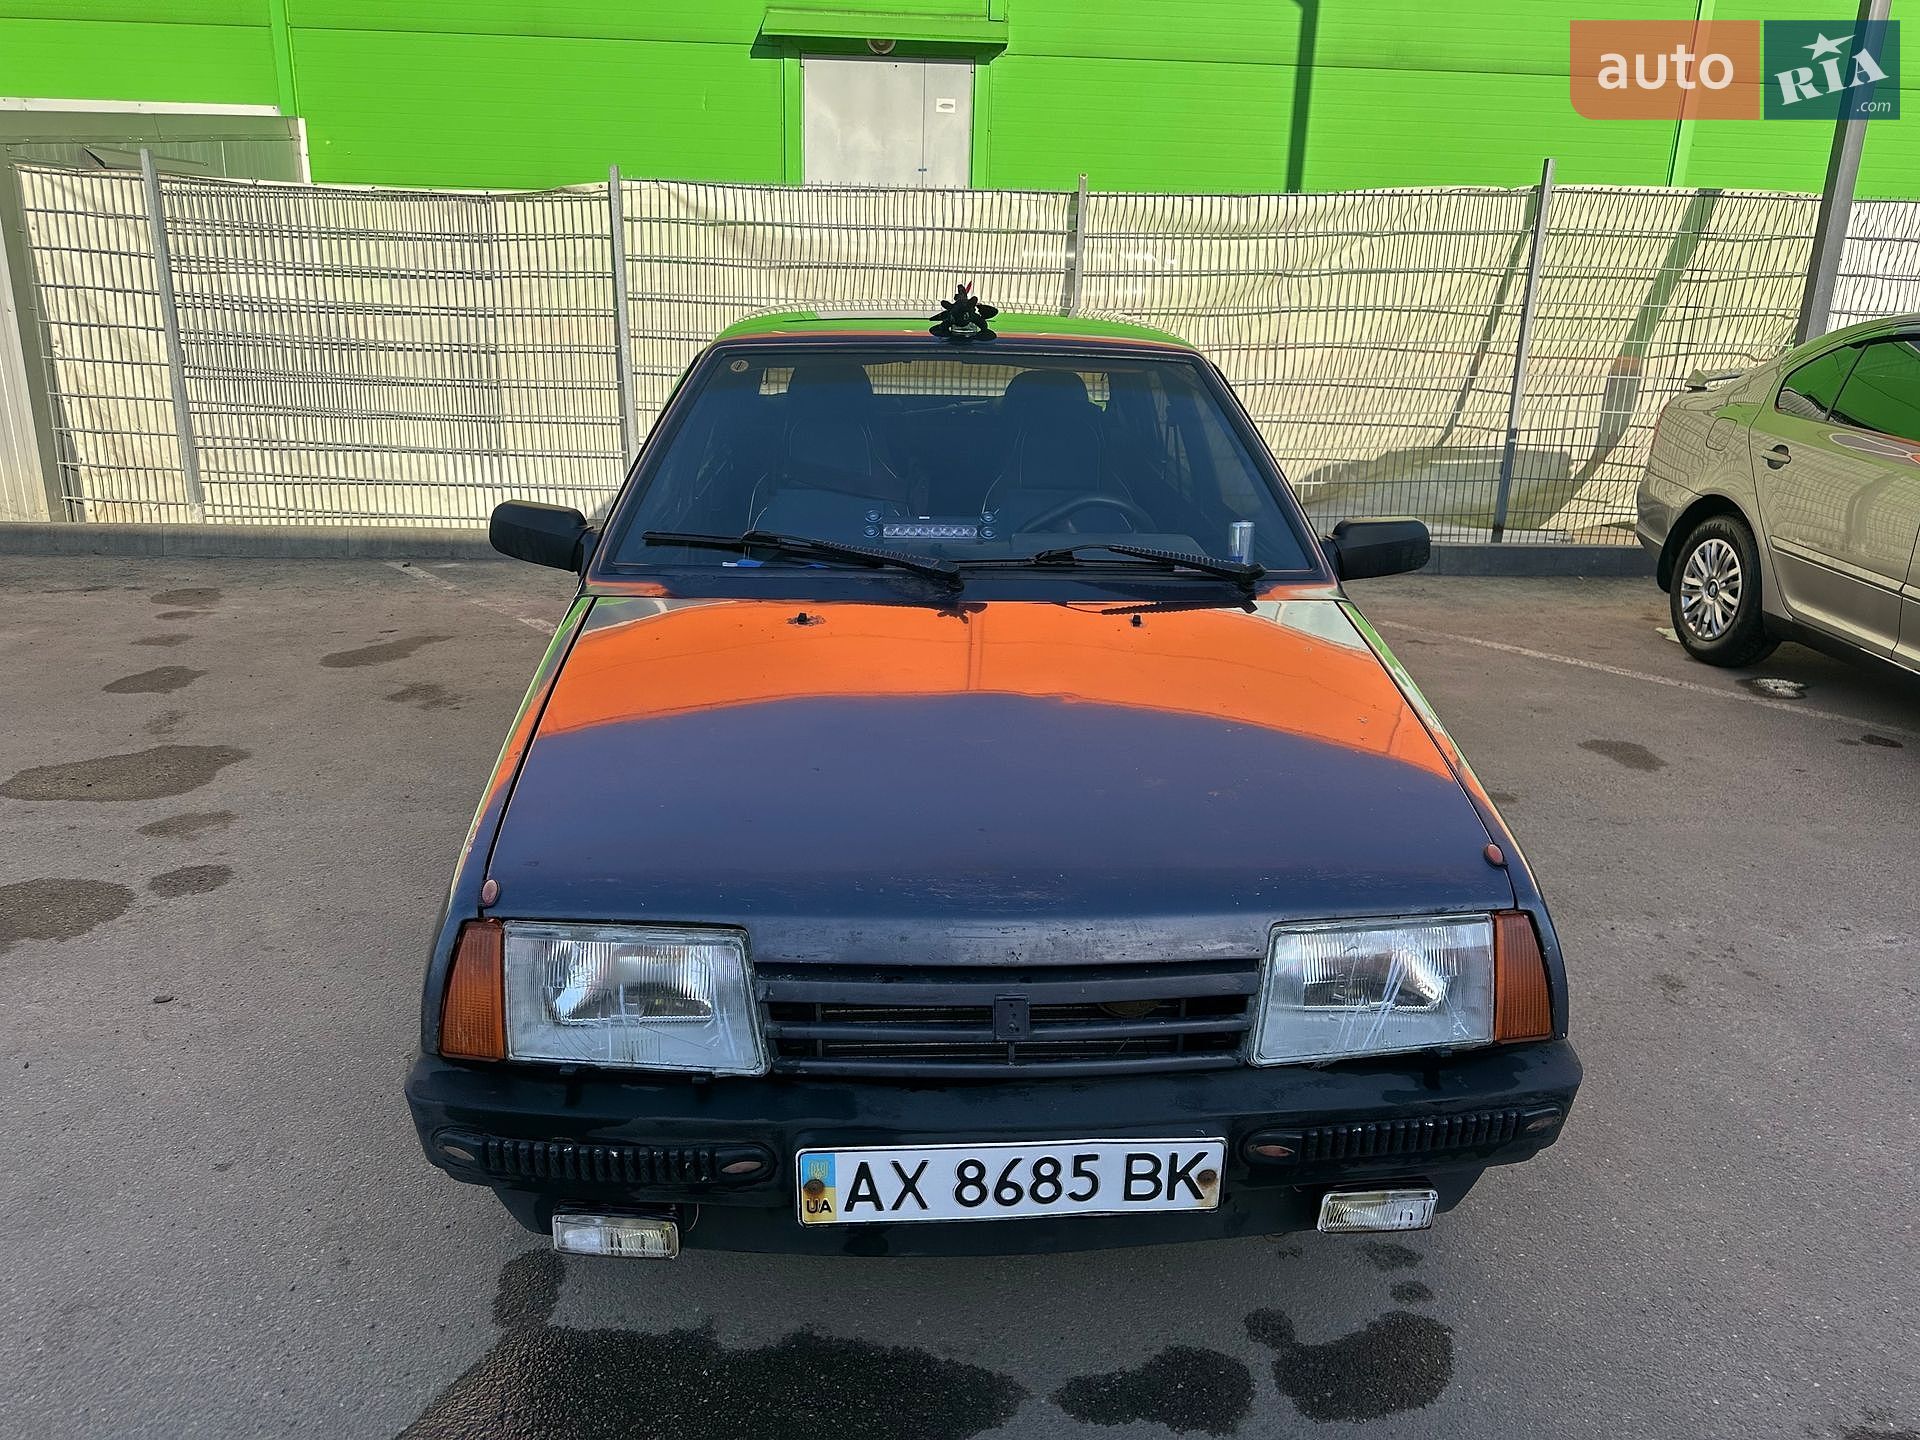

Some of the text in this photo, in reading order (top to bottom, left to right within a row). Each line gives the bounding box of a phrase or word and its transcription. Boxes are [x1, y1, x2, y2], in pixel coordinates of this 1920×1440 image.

[844, 1151, 1209, 1212] AX 8685 BK
[806, 1199, 833, 1214] UA
